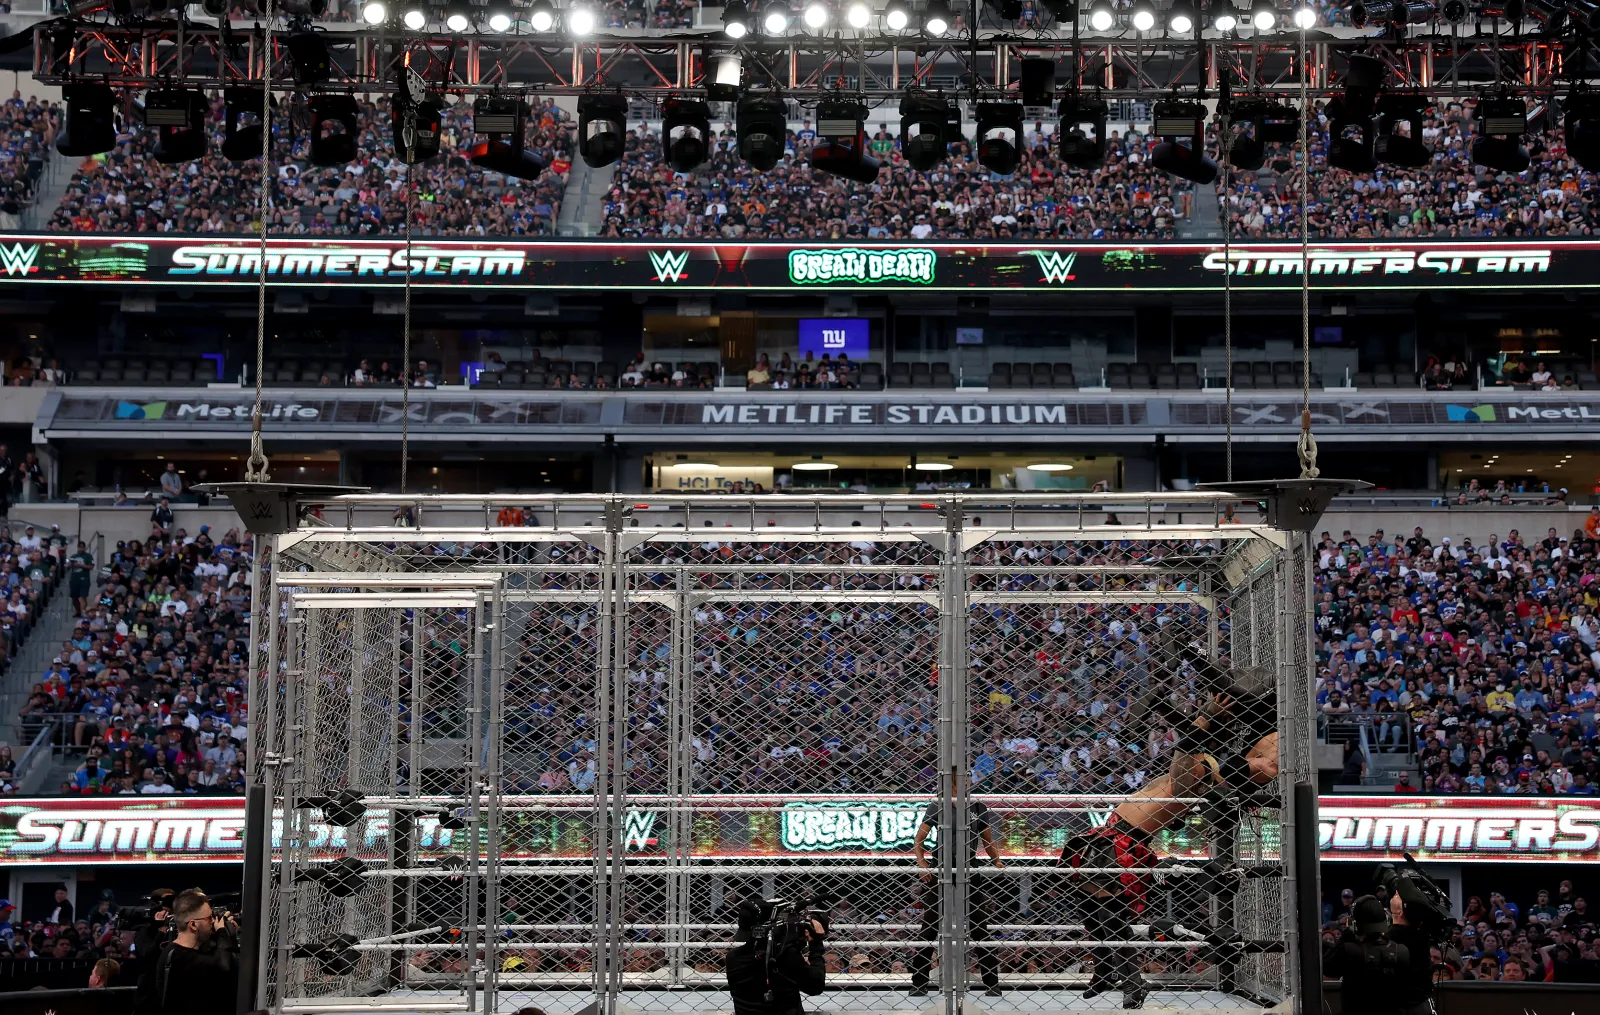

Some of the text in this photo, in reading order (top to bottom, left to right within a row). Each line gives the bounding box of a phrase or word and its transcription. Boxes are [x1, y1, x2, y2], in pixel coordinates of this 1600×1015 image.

[792, 252, 933, 281] BREATH DEATH
[177, 403, 320, 418] MetLife
[702, 405, 1067, 424] METLIFE STADIUM
